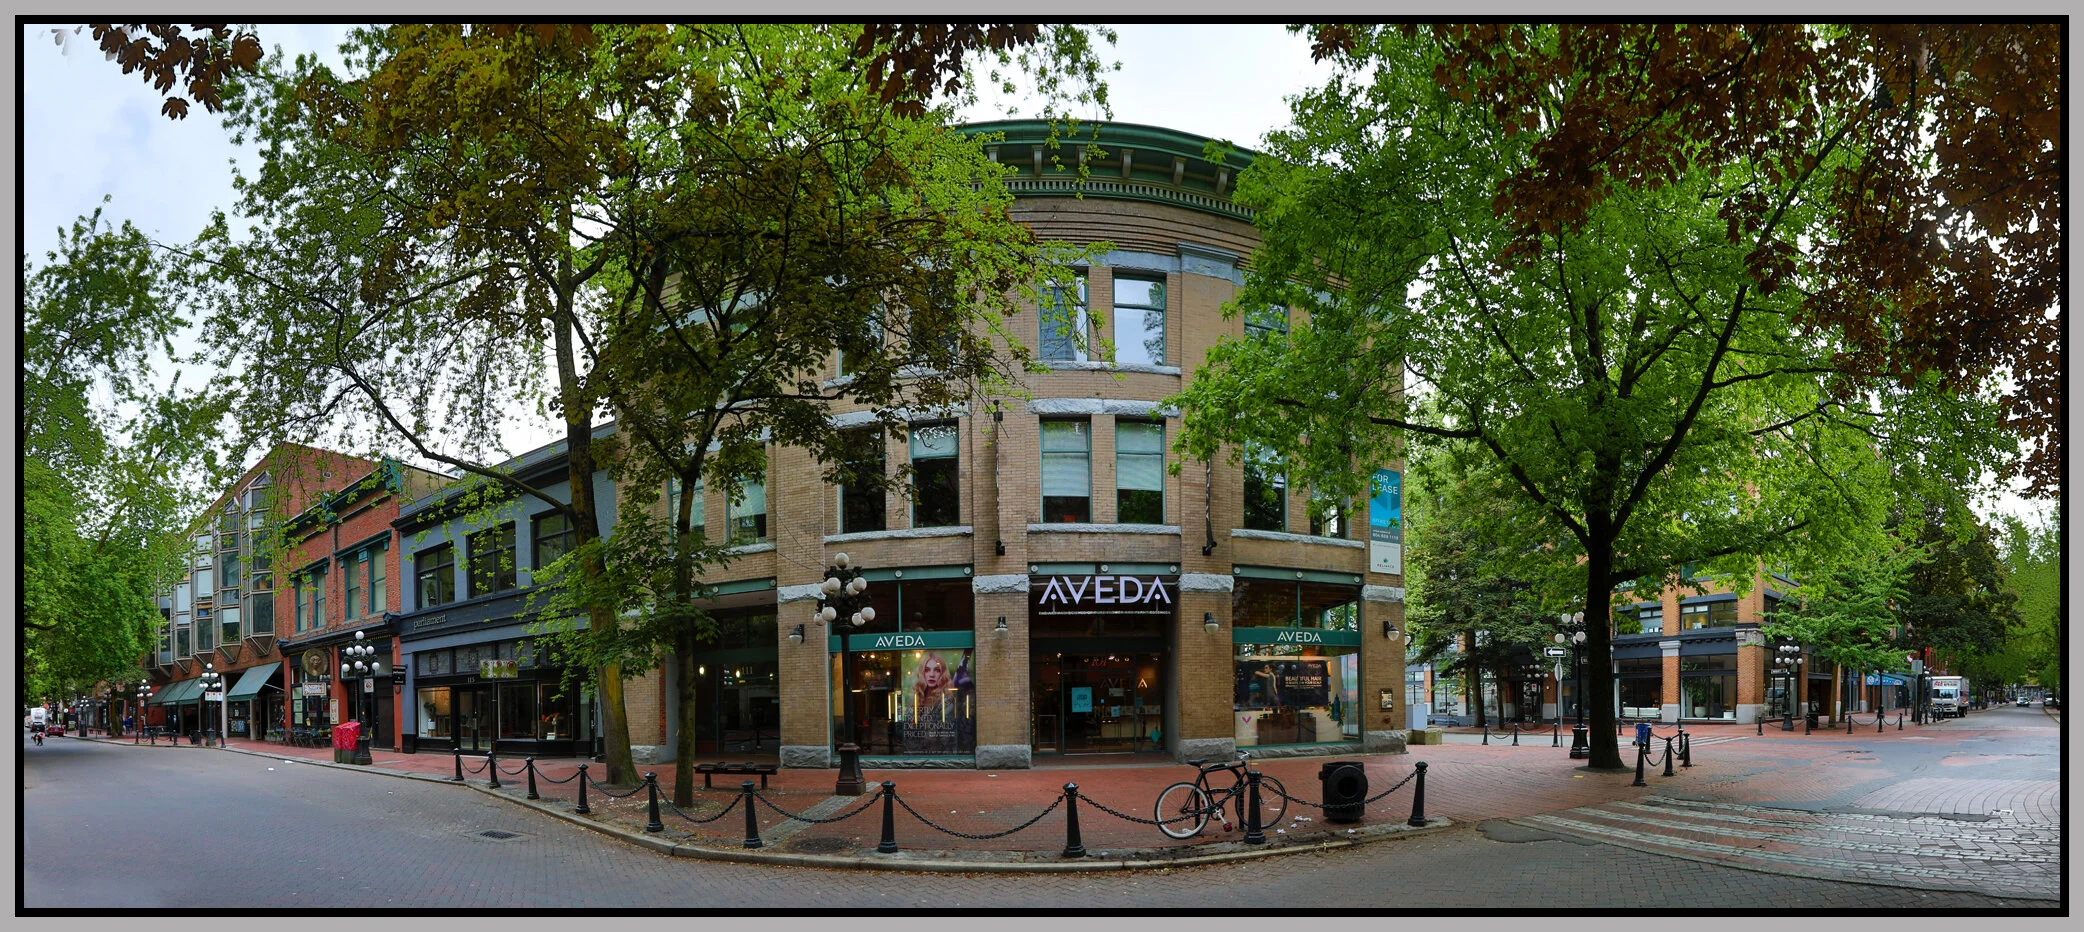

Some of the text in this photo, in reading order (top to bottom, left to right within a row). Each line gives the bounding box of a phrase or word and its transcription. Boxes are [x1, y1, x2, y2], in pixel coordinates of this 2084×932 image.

[1372, 473, 1389, 483] FOR
[1372, 483, 1398, 495] LEASE
[1039, 576, 1171, 605] AVEDA
[413, 613, 447, 631] parliament
[875, 635, 926, 648] AVEDA
[1277, 631, 1322, 642] AVEDA
